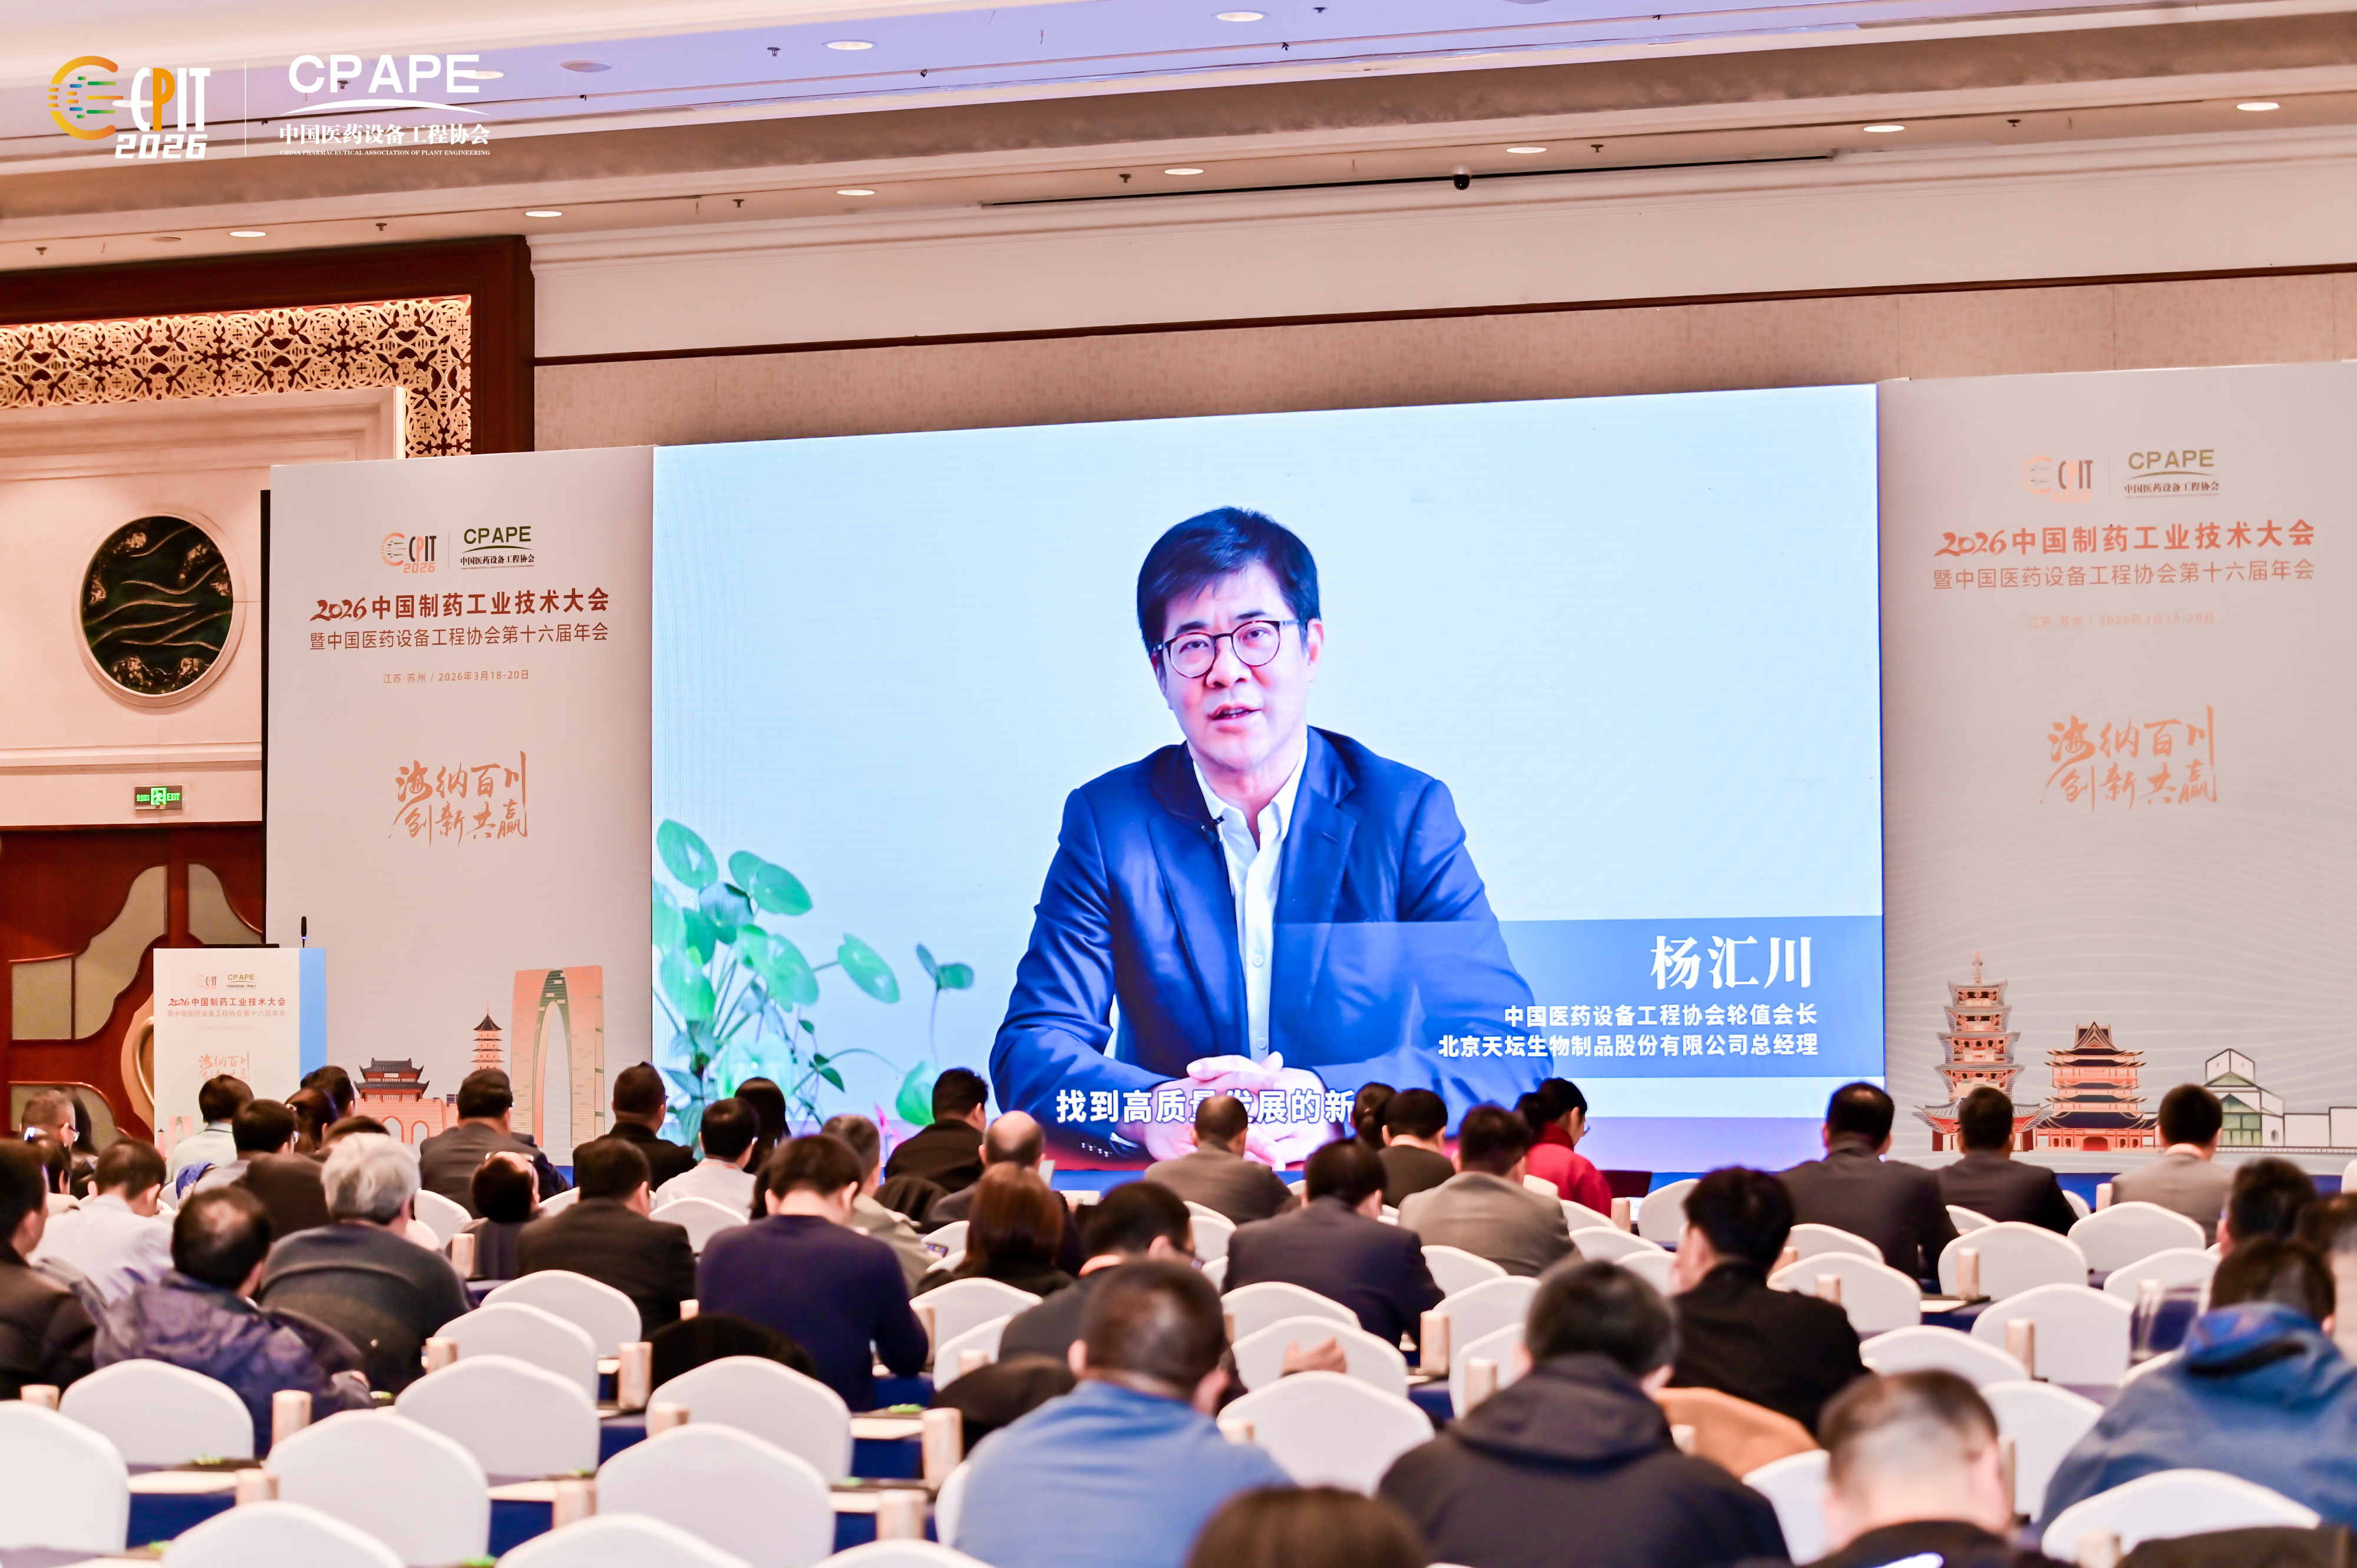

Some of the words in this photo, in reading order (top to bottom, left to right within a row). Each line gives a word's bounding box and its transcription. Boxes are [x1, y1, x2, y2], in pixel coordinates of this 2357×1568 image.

[2128, 449, 2214, 470] CPAPE
[2058, 460, 2093, 490] CPIT
[2124, 481, 2219, 494] 中国医药设备工程协会
[409, 535, 437, 562] CPIT
[464, 526, 532, 544] CPAPE
[1933, 519, 2315, 557] 2026中国制药工业技术大会
[403, 562, 435, 574] 2026
[460, 554, 535, 566] 中国医药设备工程协会
[1932, 558, 2315, 590] 暨中国医药设备工程协会第十六届年会
[309, 587, 609, 622] 2026中国制药工业技术大会
[309, 622, 609, 651] 暨中国医药设备工程协会第十六届年会
[438, 669, 529, 681] 2026年3月18-20日
[2045, 704, 2214, 779] 海纳百川
[167, 793, 180, 801] EXIT
[392, 750, 526, 817] 海纳百川
[2060, 758, 2217, 812] 创新共赢
[404, 798, 528, 847] 创新共赢
[1649, 935, 1813, 990] 杨汇川
[167, 997, 286, 1006] 2026中国制药工业技术大会
[1504, 1002, 1817, 1027] 中国医药设备工程协会轮值会长
[1438, 1032, 1819, 1058] 北京天坛生物制品股份有限公司总经理
